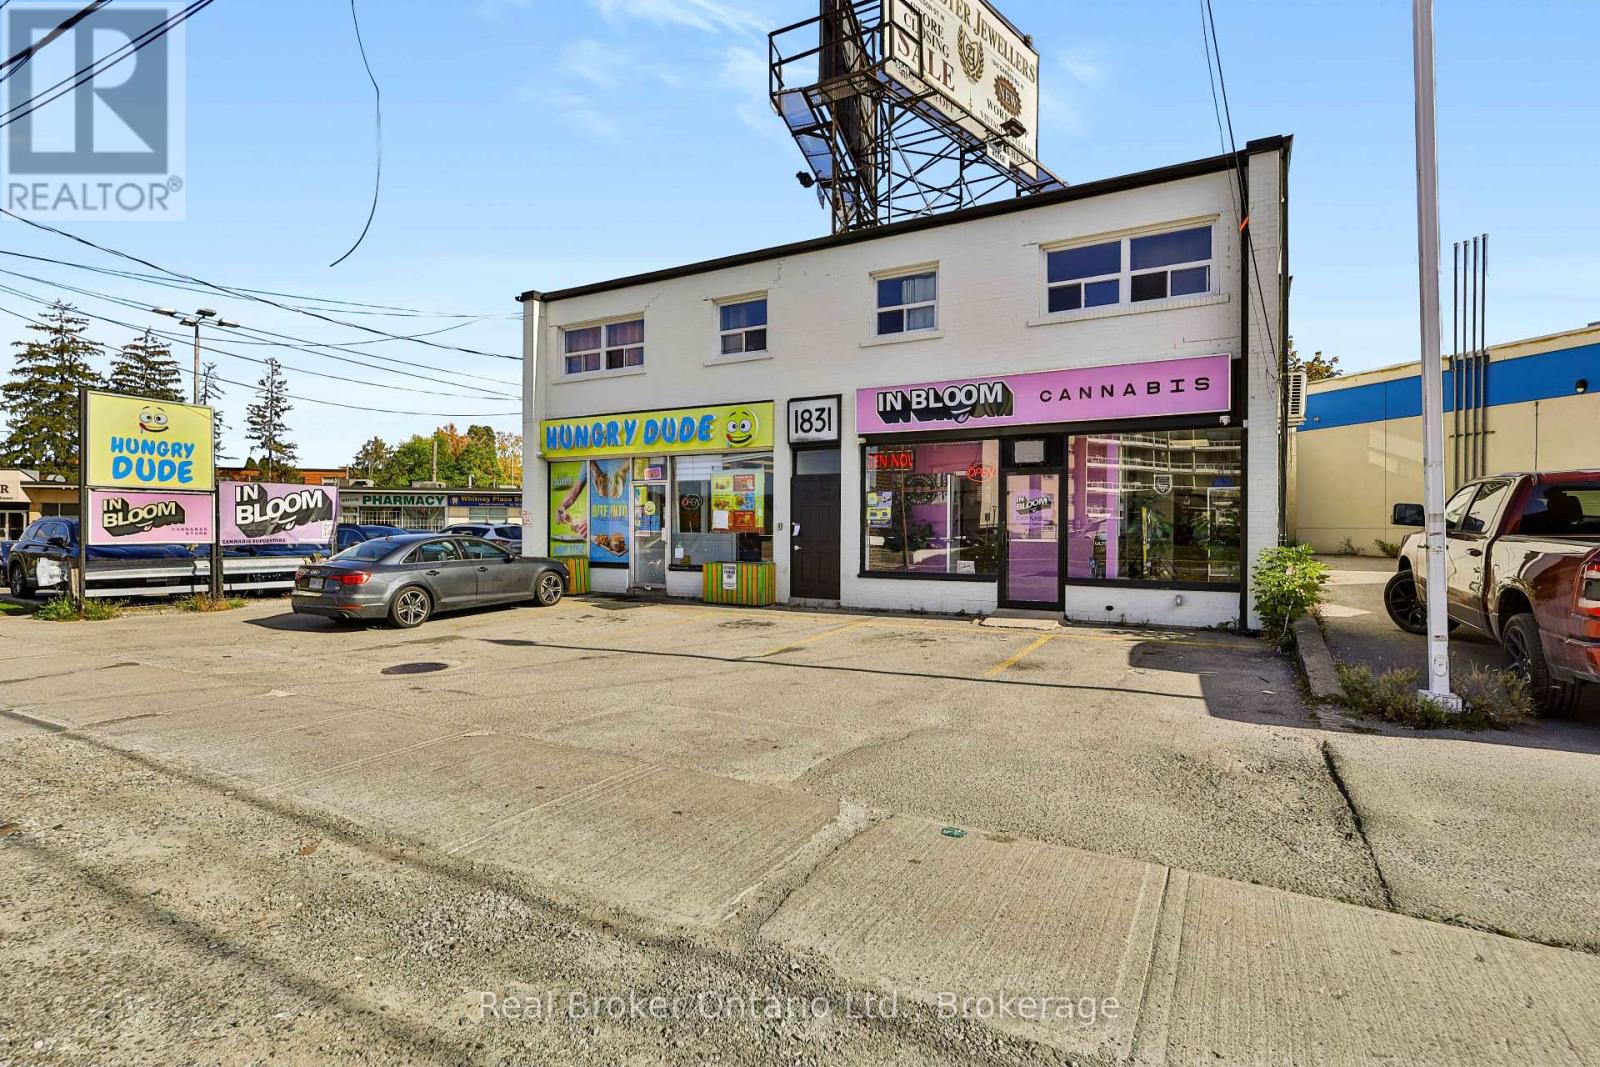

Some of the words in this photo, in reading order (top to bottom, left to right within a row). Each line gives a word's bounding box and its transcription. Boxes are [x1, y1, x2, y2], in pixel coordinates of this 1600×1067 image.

[973, 8, 1036, 84] JEWELLERS
[1000, 83, 1018, 108] NEW
[878, 392, 903, 412] IN
[911, 382, 1004, 409] BLOOM
[1039, 376, 1210, 402] CANNABIS
[545, 418, 639, 450] HUNGRY
[643, 414, 718, 446] DUDE
[794, 406, 832, 434] 1831
[110, 436, 195, 459] HUNGRY
[111, 455, 194, 484] DUDE
[968, 467, 995, 478] OPEN
[103, 498, 122, 511] IN
[236, 484, 259, 502] IN
[362, 495, 445, 505] PHARMACY
[460, 495, 490, 503] Whitney
[1017, 497, 1048, 511] BLOOM
[103, 501, 176, 528] BLOOM
[236, 490, 323, 525] BLOOM
